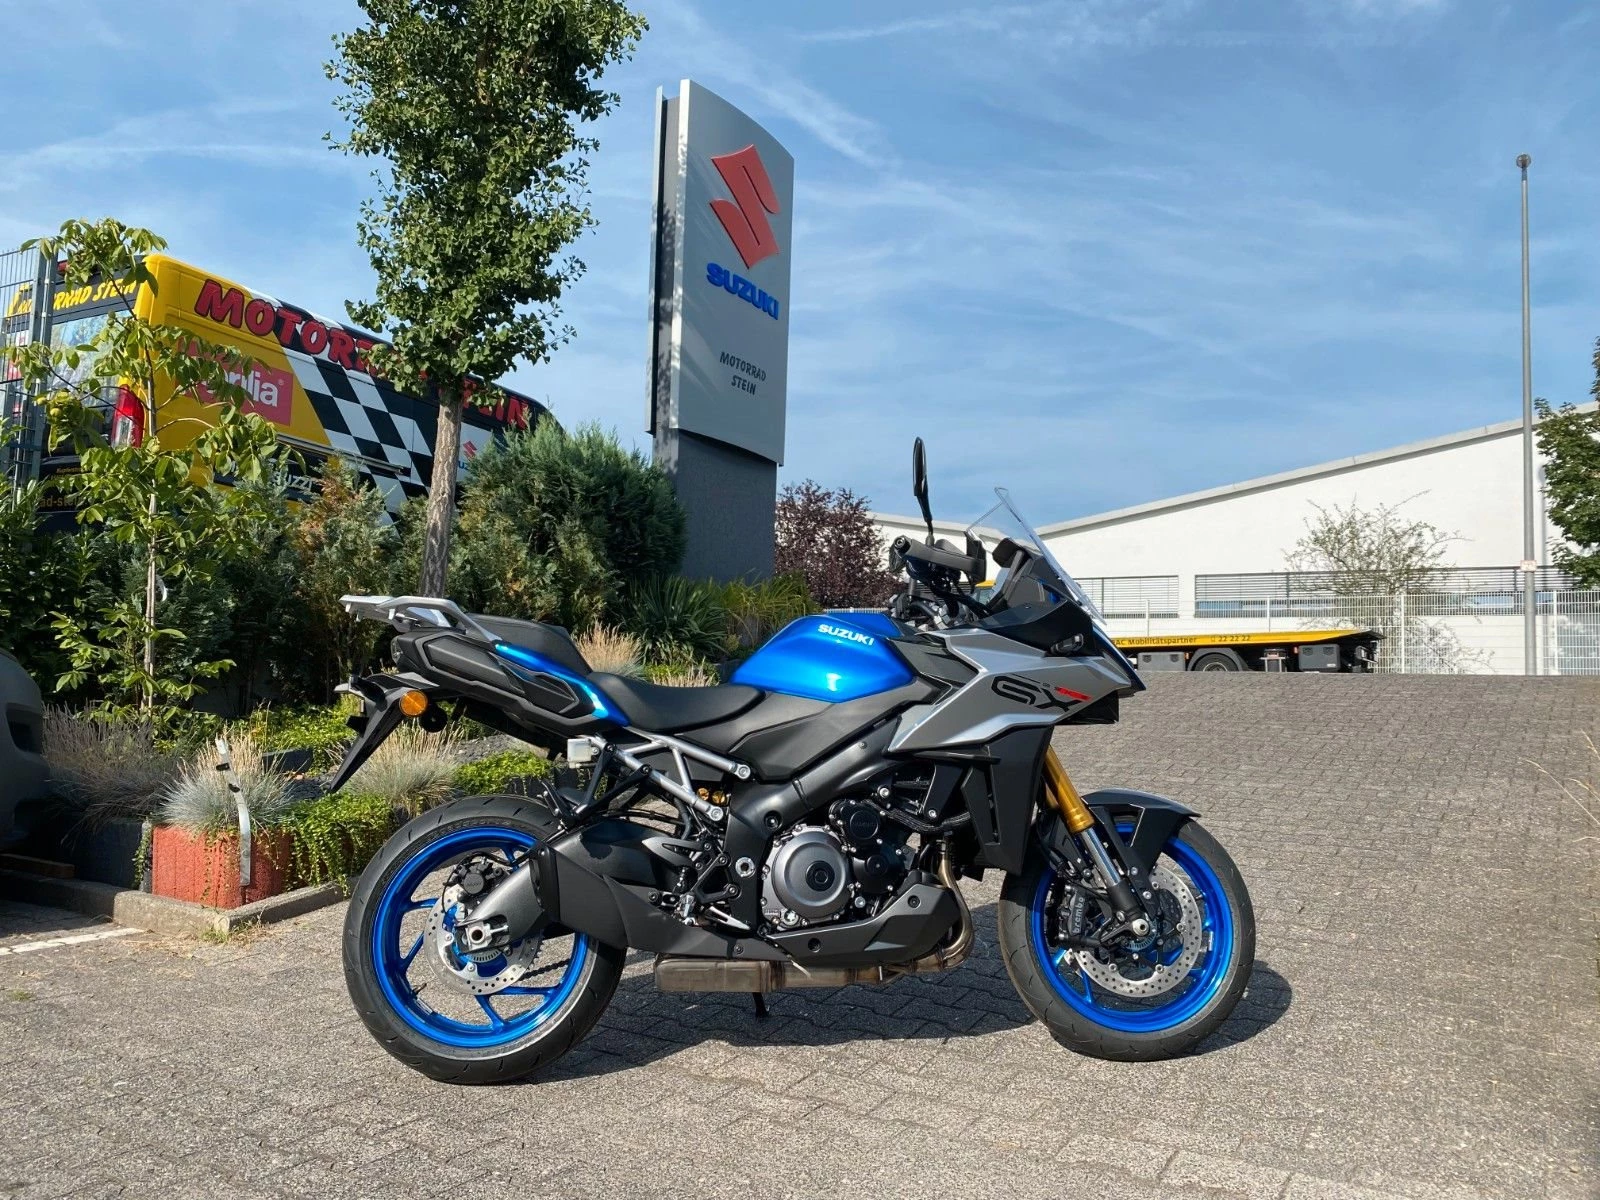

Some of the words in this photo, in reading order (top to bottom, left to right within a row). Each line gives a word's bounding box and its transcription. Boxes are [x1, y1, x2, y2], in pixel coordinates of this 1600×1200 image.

[706, 262, 779, 321] SUZUKI
[720, 351, 766, 381] MOTORRAD
[731, 374, 756, 395] STEIN
[818, 623, 875, 646] SUZUKI
[1128, 636, 1197, 646] Mobilitätspartner
[1072, 897, 1084, 934] brembo
